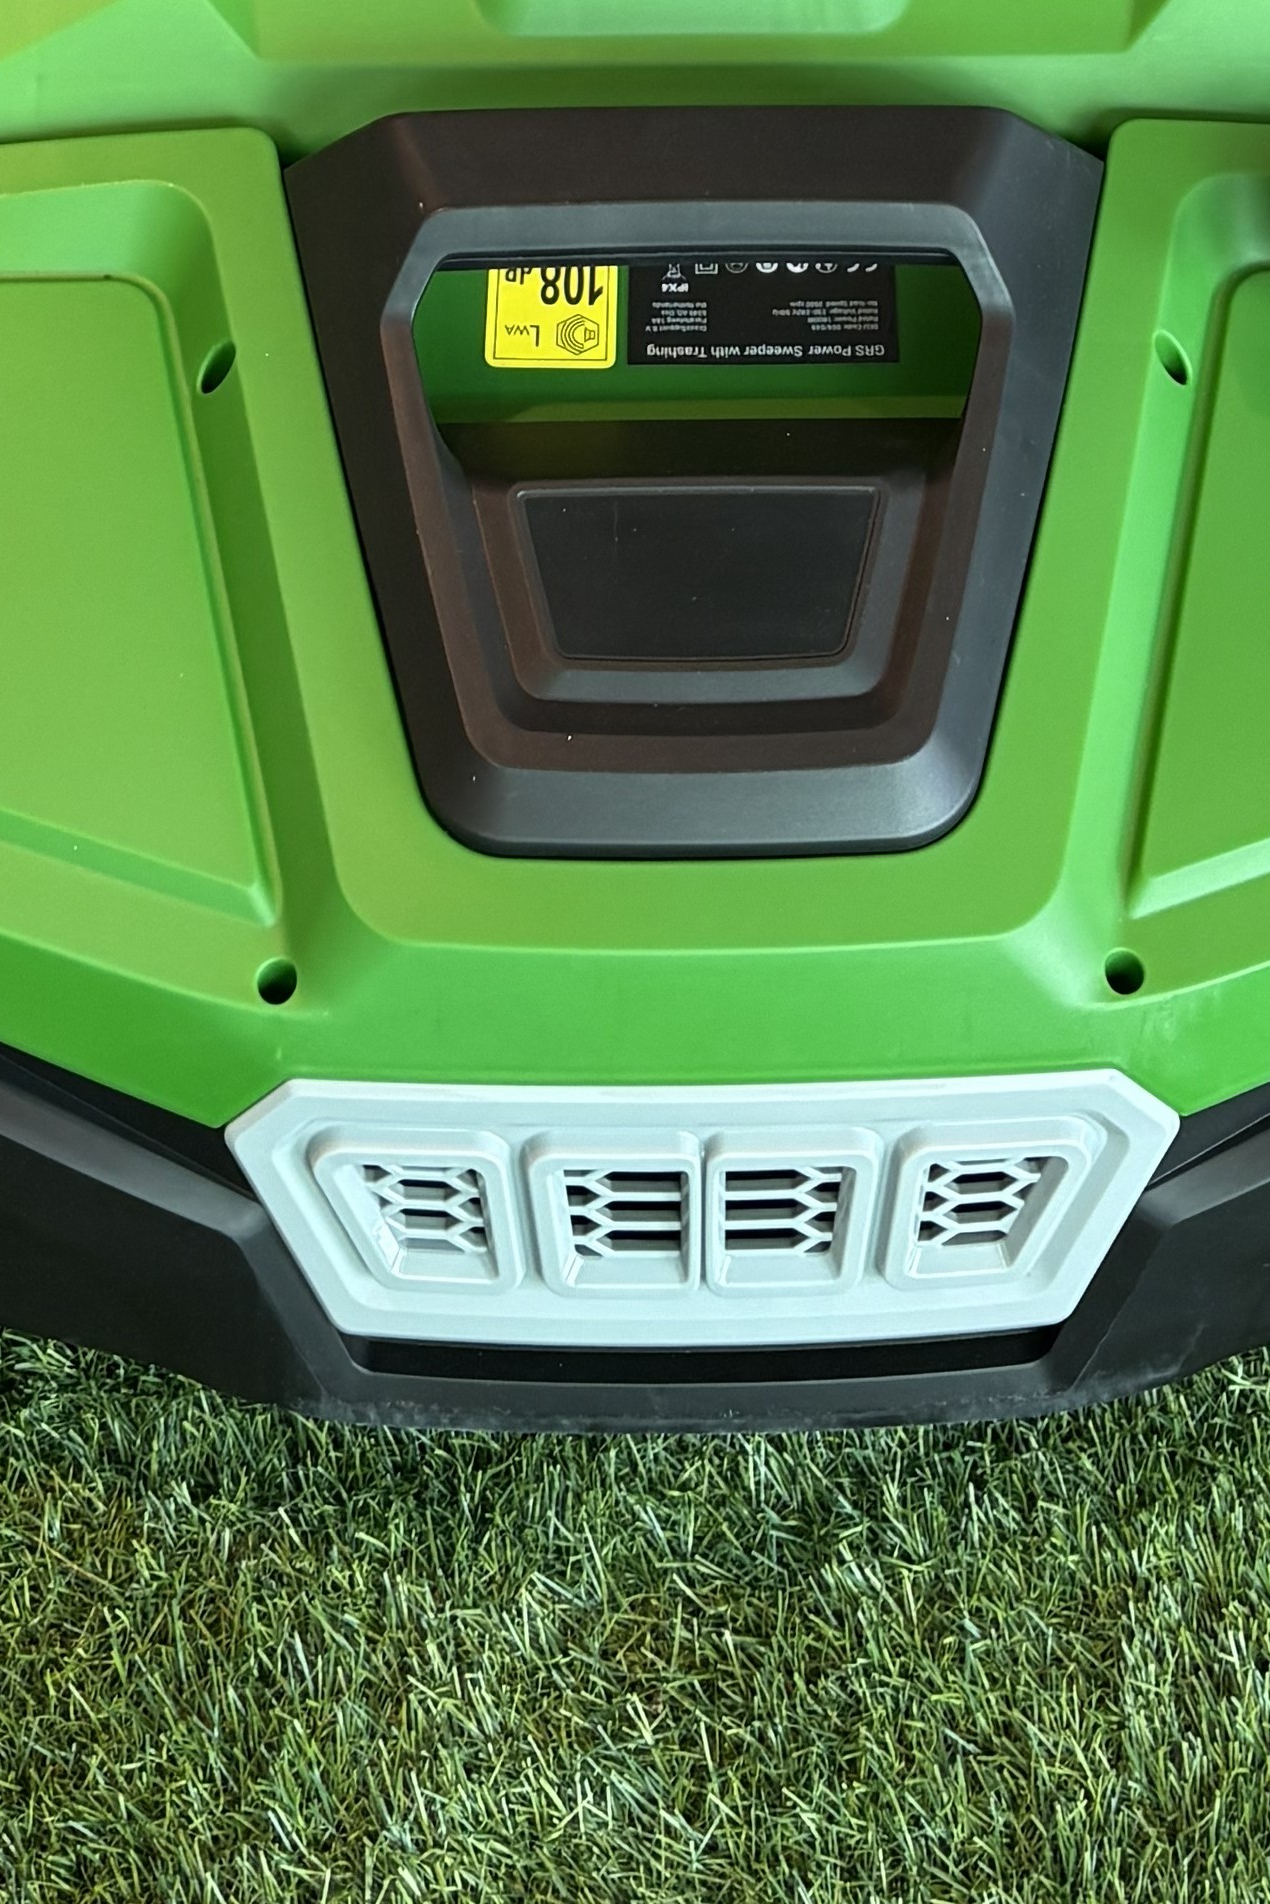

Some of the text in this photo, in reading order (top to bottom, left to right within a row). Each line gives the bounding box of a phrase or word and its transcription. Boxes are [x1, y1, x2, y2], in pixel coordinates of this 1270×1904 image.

[540, 265, 603, 306] 108
[661, 282, 689, 293] IPX4
[646, 343, 886, 359] GRS Power Sweeper with Trashing
